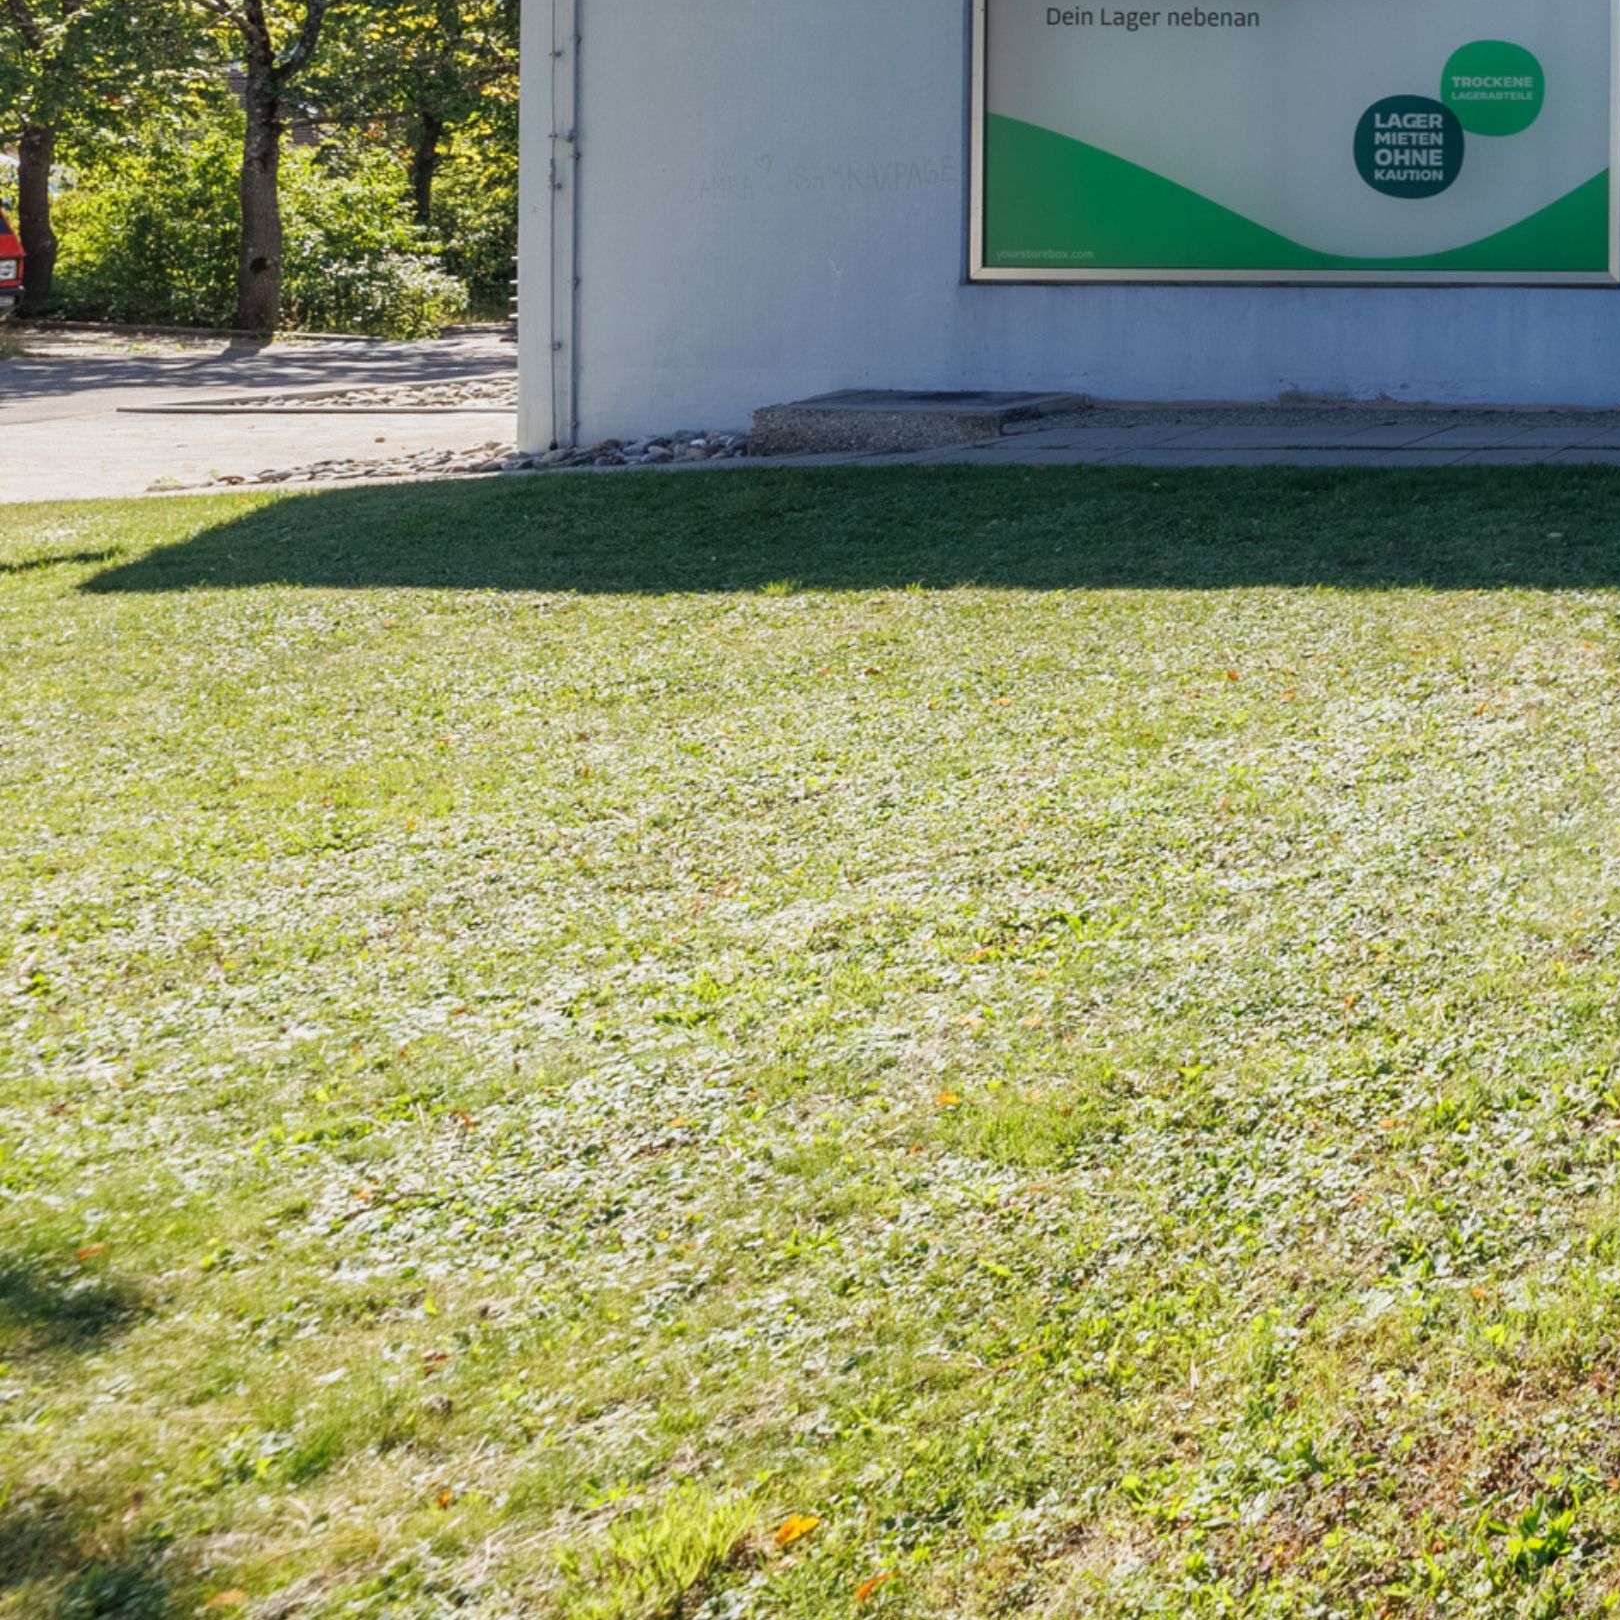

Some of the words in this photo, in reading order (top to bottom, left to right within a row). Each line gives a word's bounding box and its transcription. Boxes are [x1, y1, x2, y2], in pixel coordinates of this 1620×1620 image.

[1047, 7, 1093, 25] Dein
[1101, 7, 1160, 31] Lager
[1168, 7, 1259, 27] nebenan
[1452, 76, 1532, 87] TROCKENE
[1452, 91, 1533, 100] LAGERABTEILE
[1375, 113, 1442, 128] LAGER
[1375, 132, 1443, 145] MIETEN
[1375, 149, 1443, 166] OHNE
[1374, 169, 1443, 180] KAUTION
[995, 248, 1094, 260] yourstorebox.com
